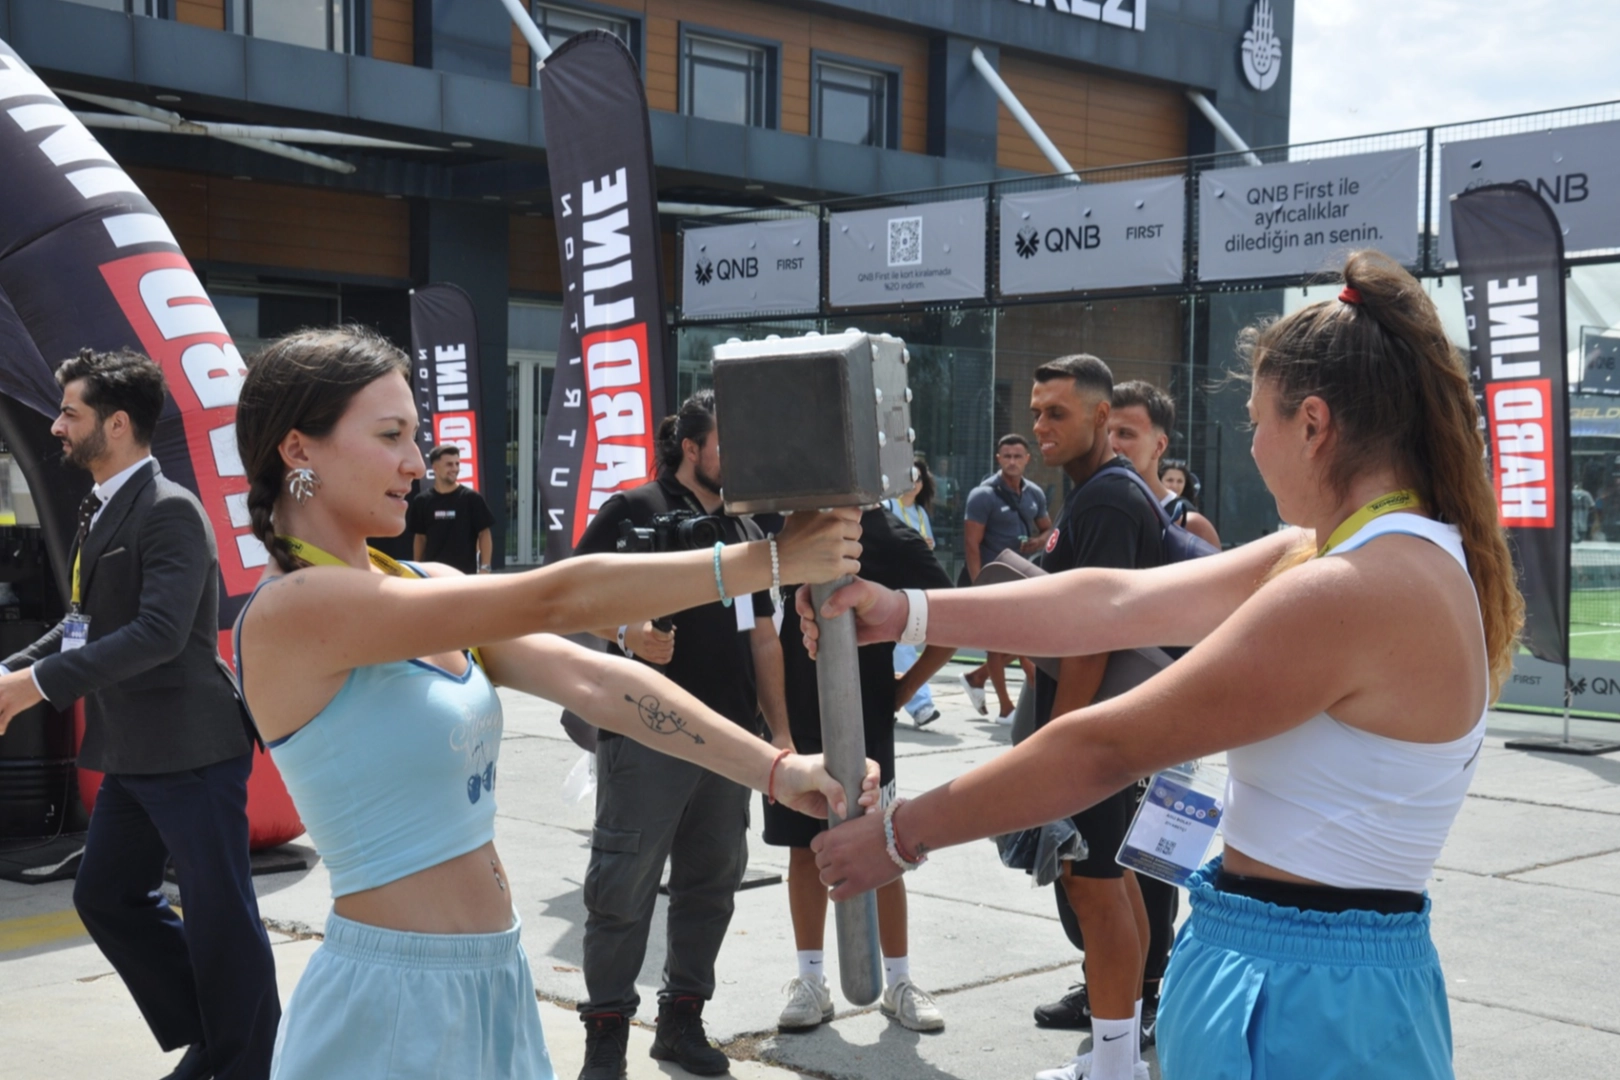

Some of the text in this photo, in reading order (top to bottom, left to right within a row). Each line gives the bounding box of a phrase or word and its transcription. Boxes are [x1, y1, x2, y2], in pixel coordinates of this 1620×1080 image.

[1246, 177, 1360, 205] QNB First ile
[1044, 224, 1164, 253] QNB FIRST
[1225, 223, 1384, 254] dilediğin an senin.
[717, 257, 805, 281] QNB FIRST
[1513, 675, 1542, 685] FIRST
